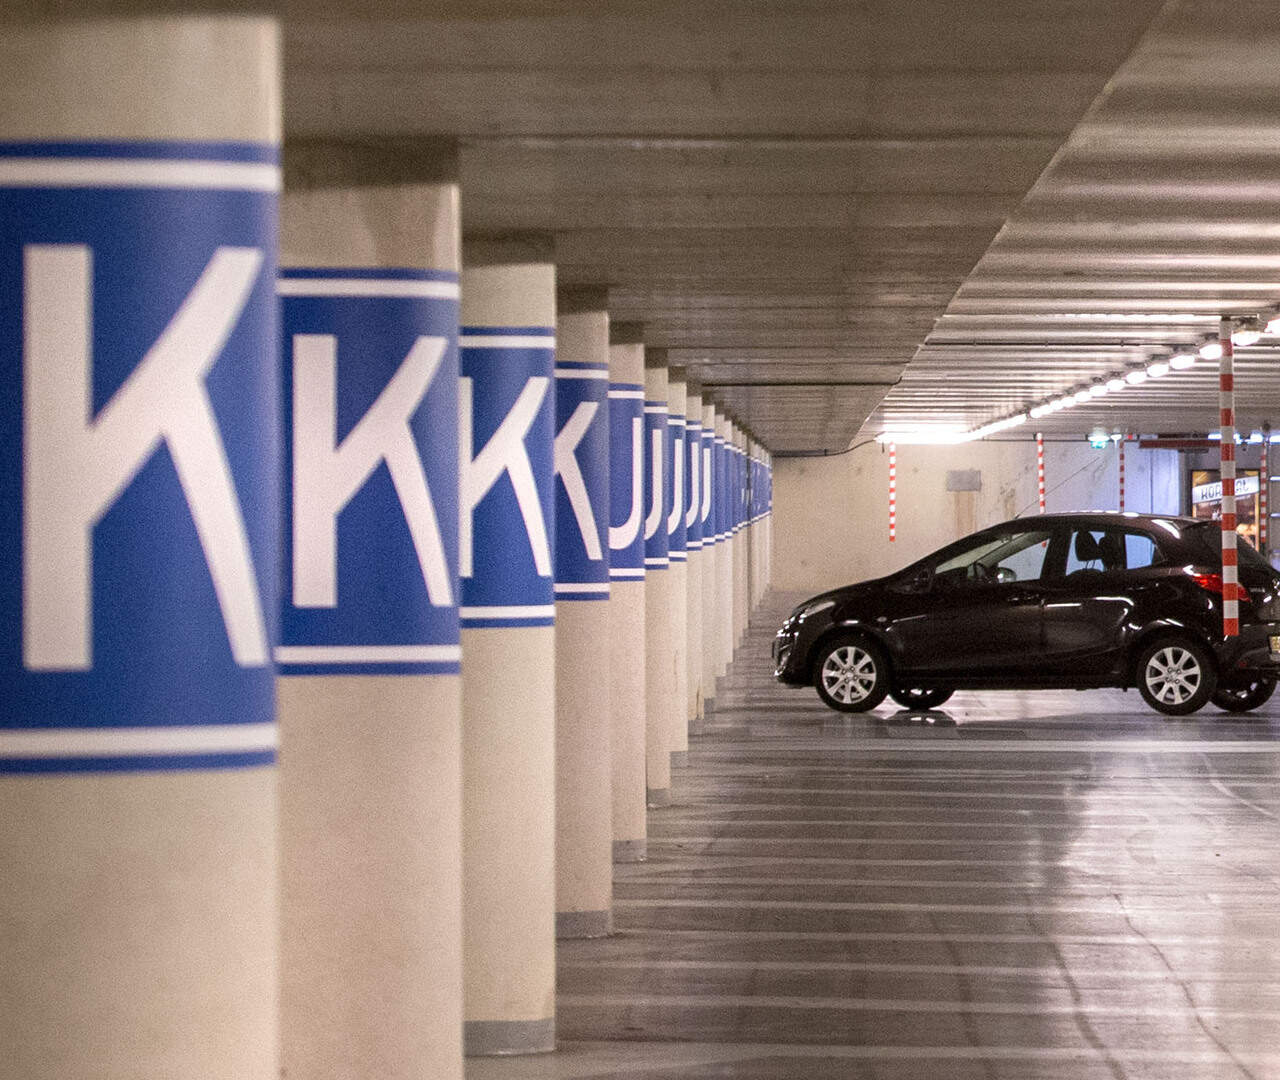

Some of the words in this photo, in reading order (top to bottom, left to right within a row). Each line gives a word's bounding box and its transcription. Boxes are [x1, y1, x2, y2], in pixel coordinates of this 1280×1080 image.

[23, 245, 268, 670] K
[292, 334, 454, 607] K
[459, 376, 553, 577] K
[608, 417, 642, 550] J
